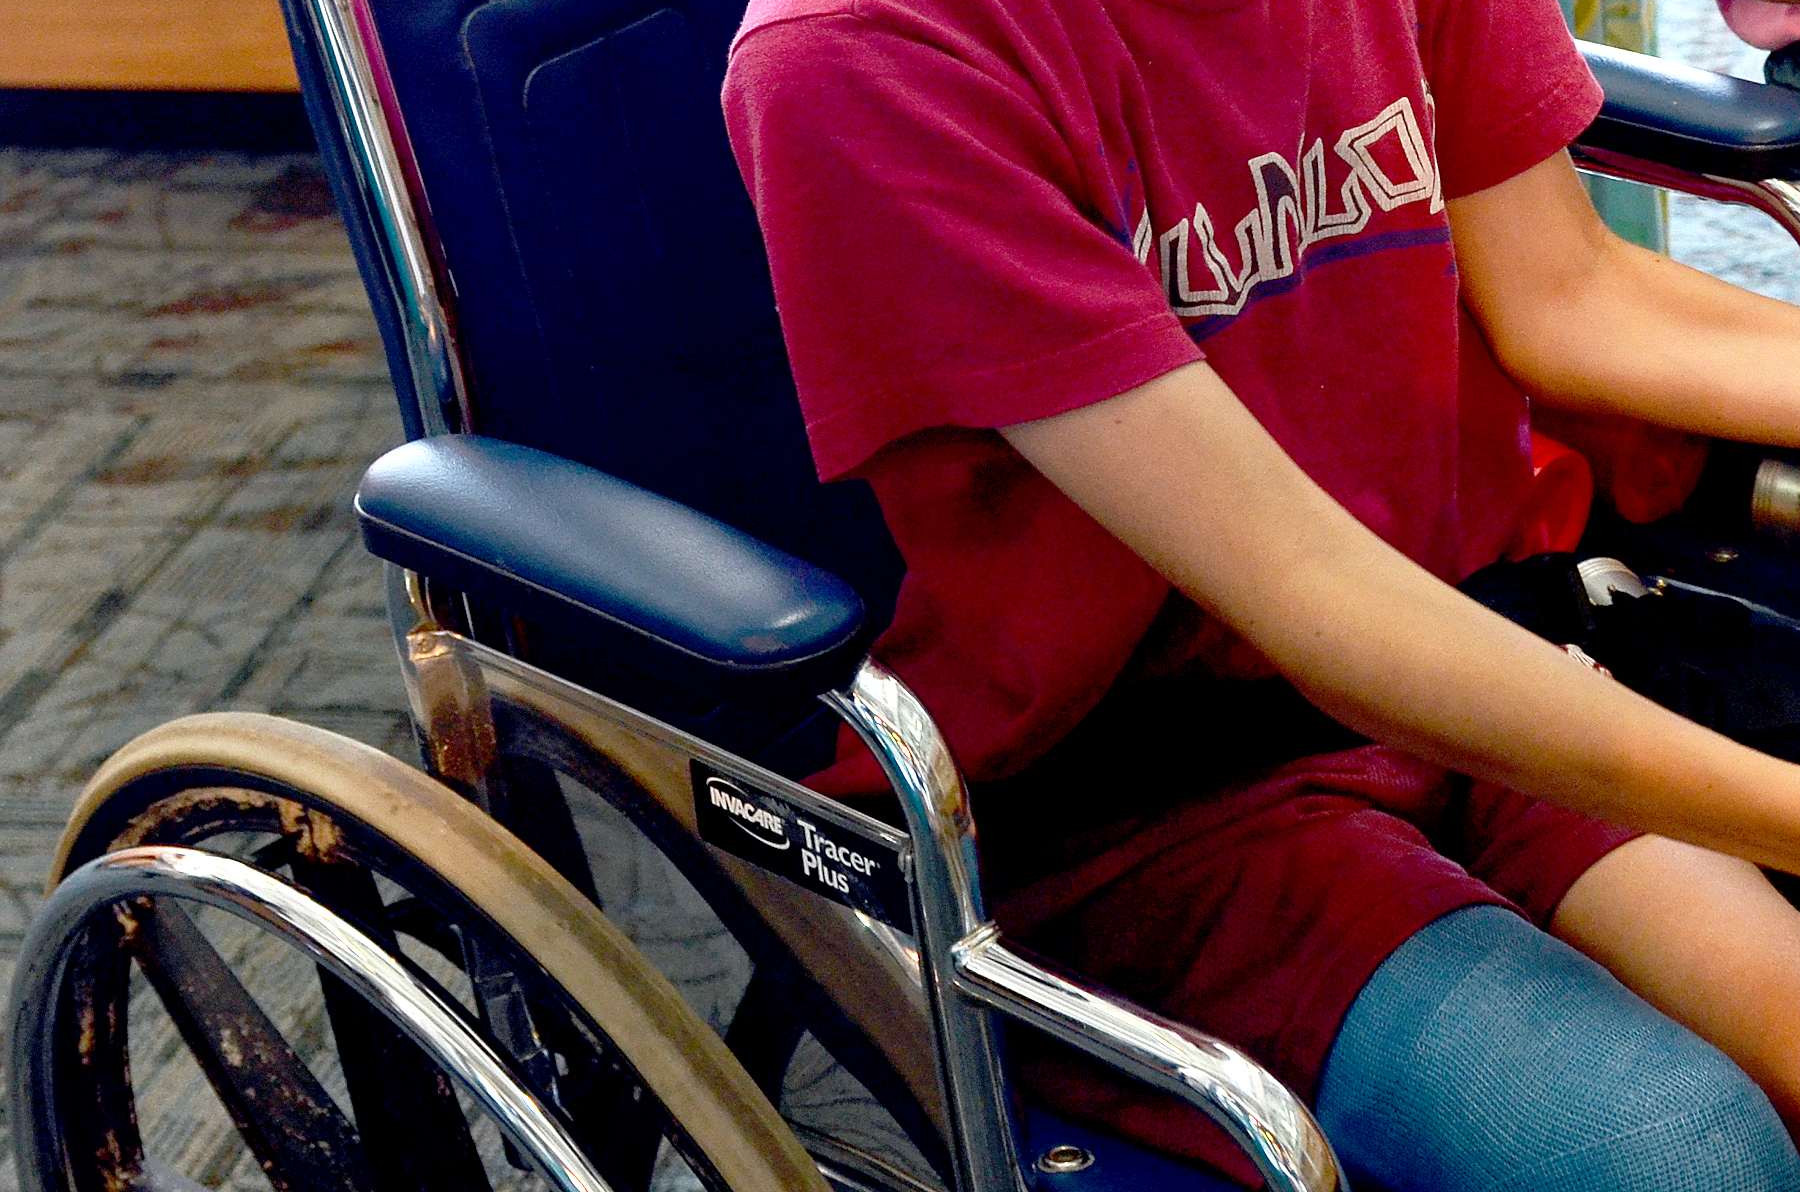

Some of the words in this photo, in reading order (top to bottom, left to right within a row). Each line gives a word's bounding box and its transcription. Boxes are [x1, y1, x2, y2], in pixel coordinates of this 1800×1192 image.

[709, 786, 784, 836] INVACARE
[797, 818, 875, 877] Tracer
[801, 848, 850, 894] Plus
